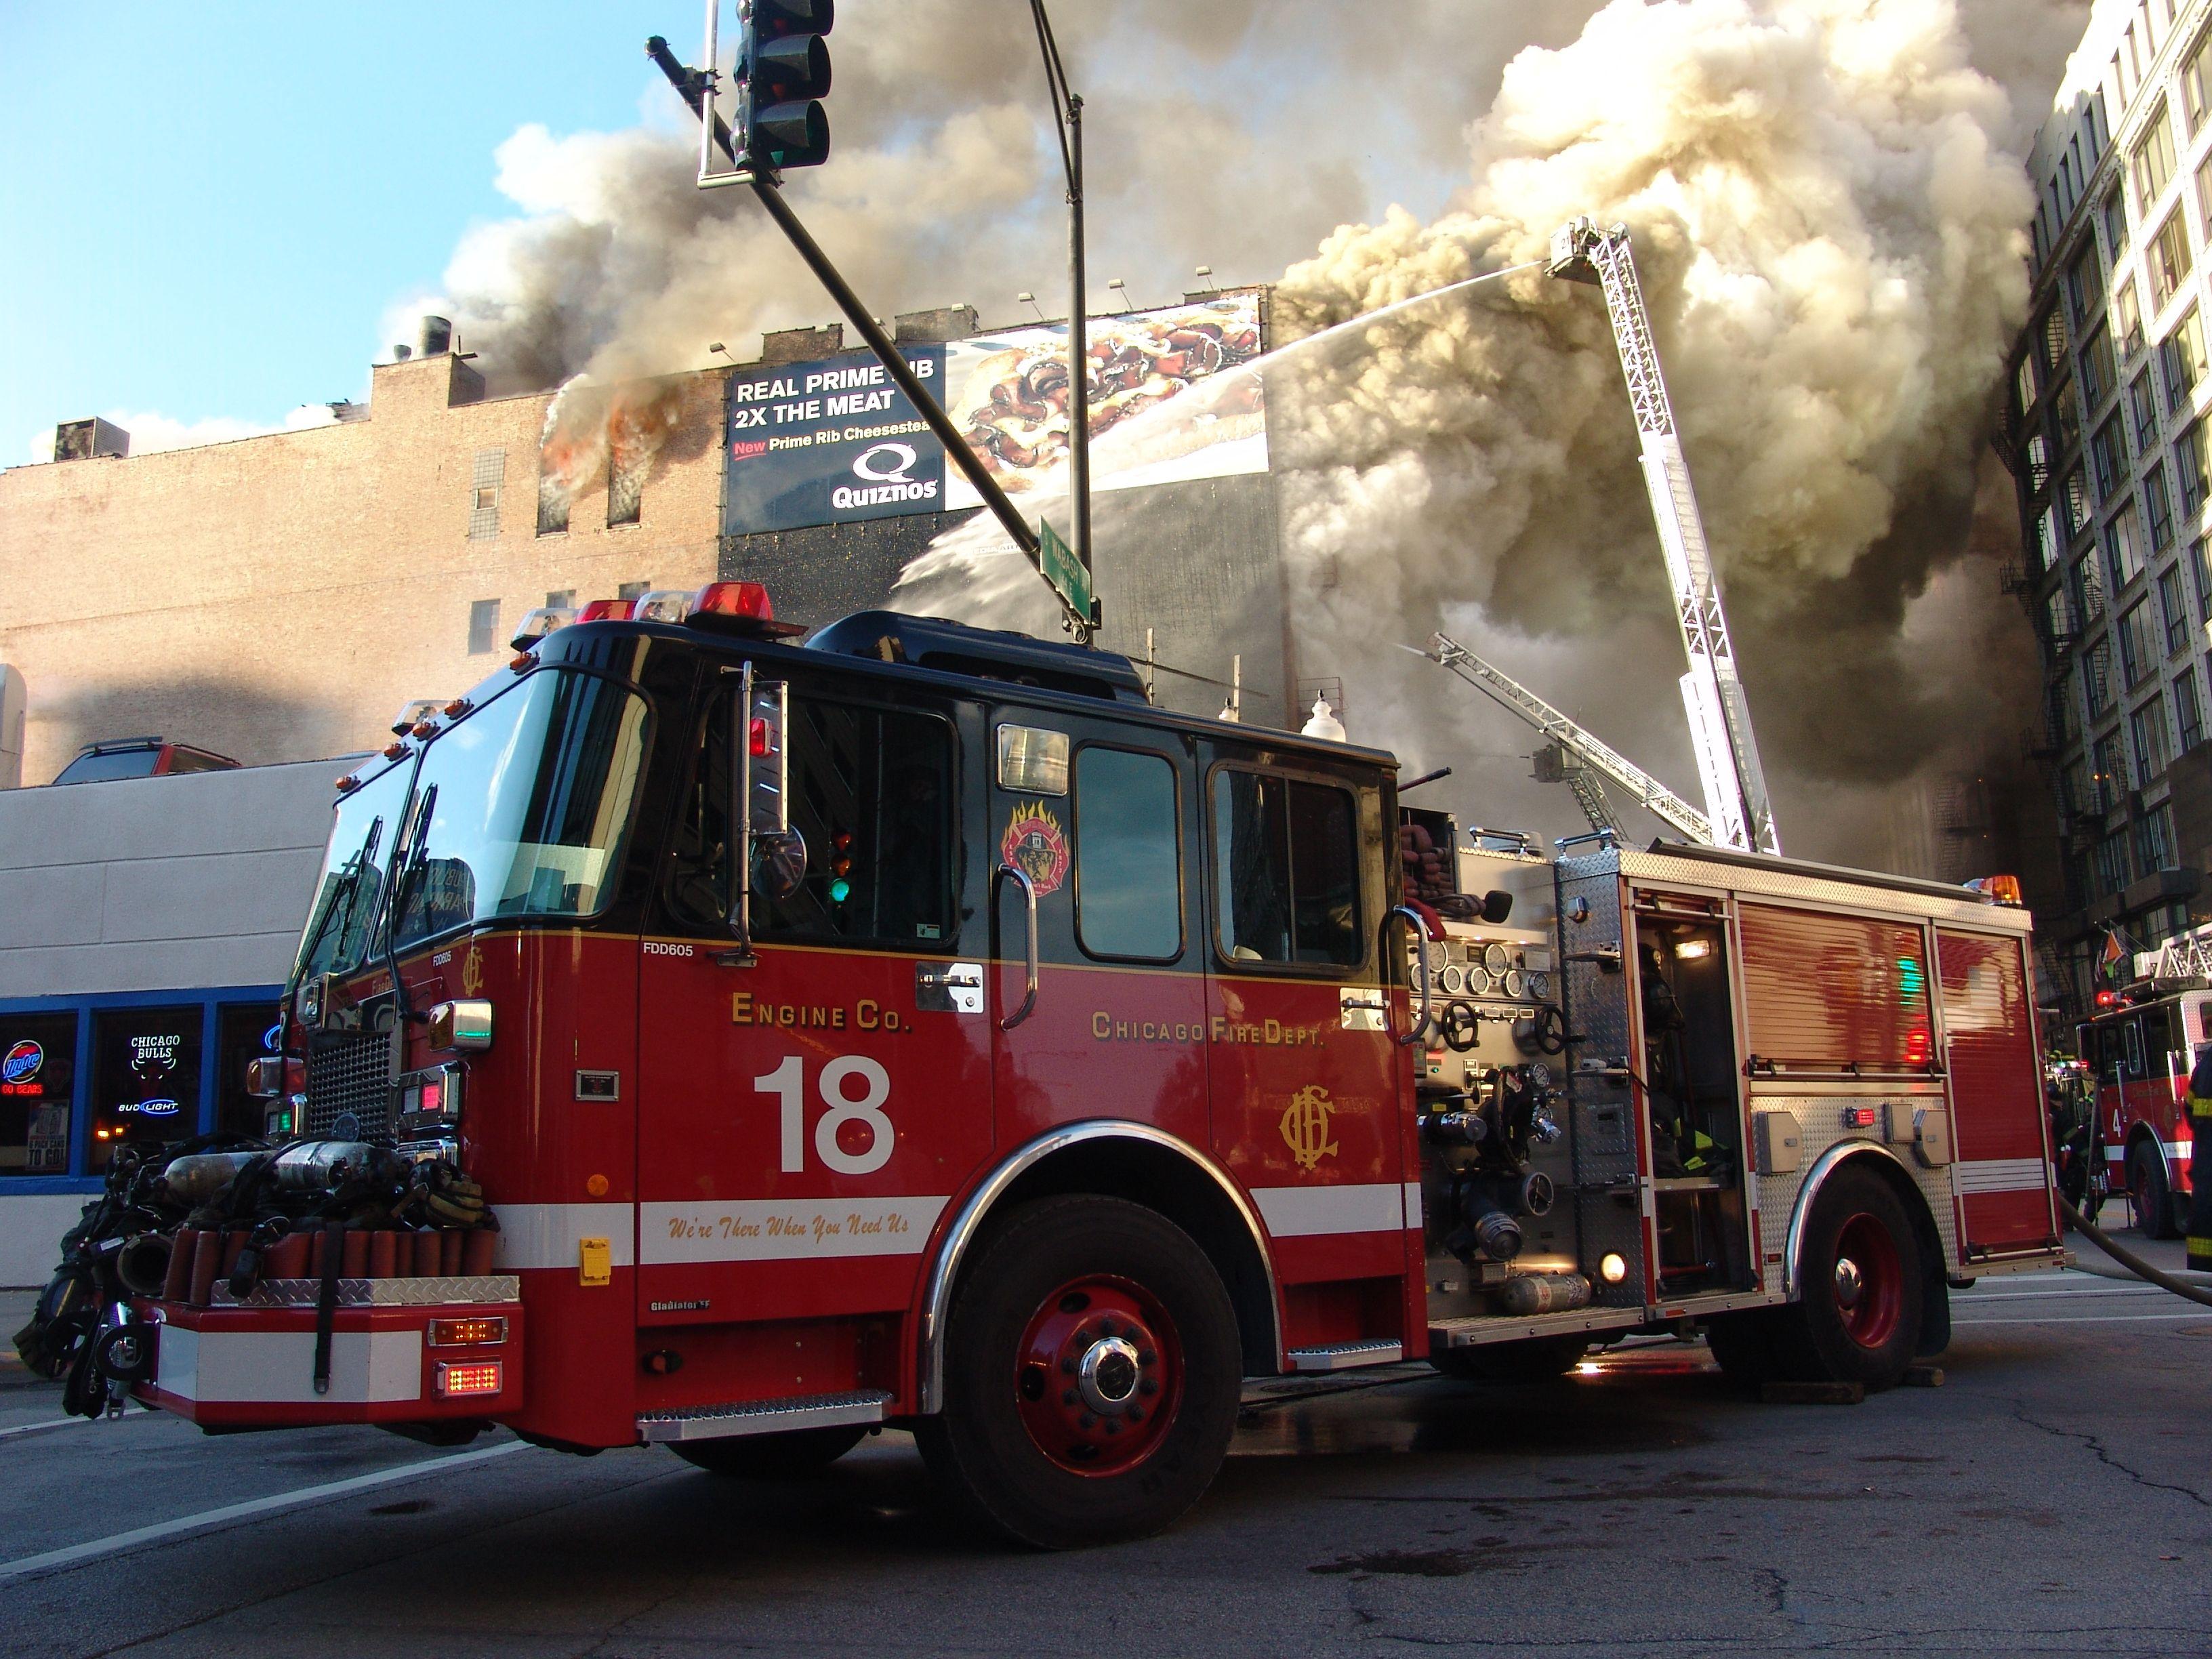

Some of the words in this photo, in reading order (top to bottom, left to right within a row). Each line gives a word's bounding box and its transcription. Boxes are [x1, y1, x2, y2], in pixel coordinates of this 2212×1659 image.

[737, 378, 799, 403] REAL
[806, 365, 885, 394] PRIME
[735, 407, 768, 429] 2X
[773, 400, 821, 424] THE
[827, 389, 895, 416] MEAT
[734, 441, 766, 455] New
[769, 436, 813, 451] Prime
[815, 430, 841, 445] Rib
[843, 419, 932, 441] Cheesestea
[643, 942, 693, 957] FDD605
[732, 991, 844, 1027] ENGINE
[1092, 1010, 1205, 1041] CHICAGO
[1211, 1016, 1260, 1044] FIRE
[131, 1035, 180, 1048] CHICAGO
[138, 1047, 172, 1059] BULLS
[16, 1084, 43, 1094] BEARS
[145, 1103, 179, 1111] LIGHT
[754, 1054, 895, 1175] 18
[2112, 1109, 2121, 1137] 4
[28, 1149, 42, 1166] TO
[45, 1149, 65, 1165] GO!
[668, 1217, 712, 1238] We're
[718, 1216, 761, 1240] There
[766, 1216, 806, 1237] When
[813, 1214, 840, 1244] You
[847, 1212, 882, 1235] Need
[887, 1213, 909, 1233] Us
[651, 1300, 697, 1311] Gladiator
